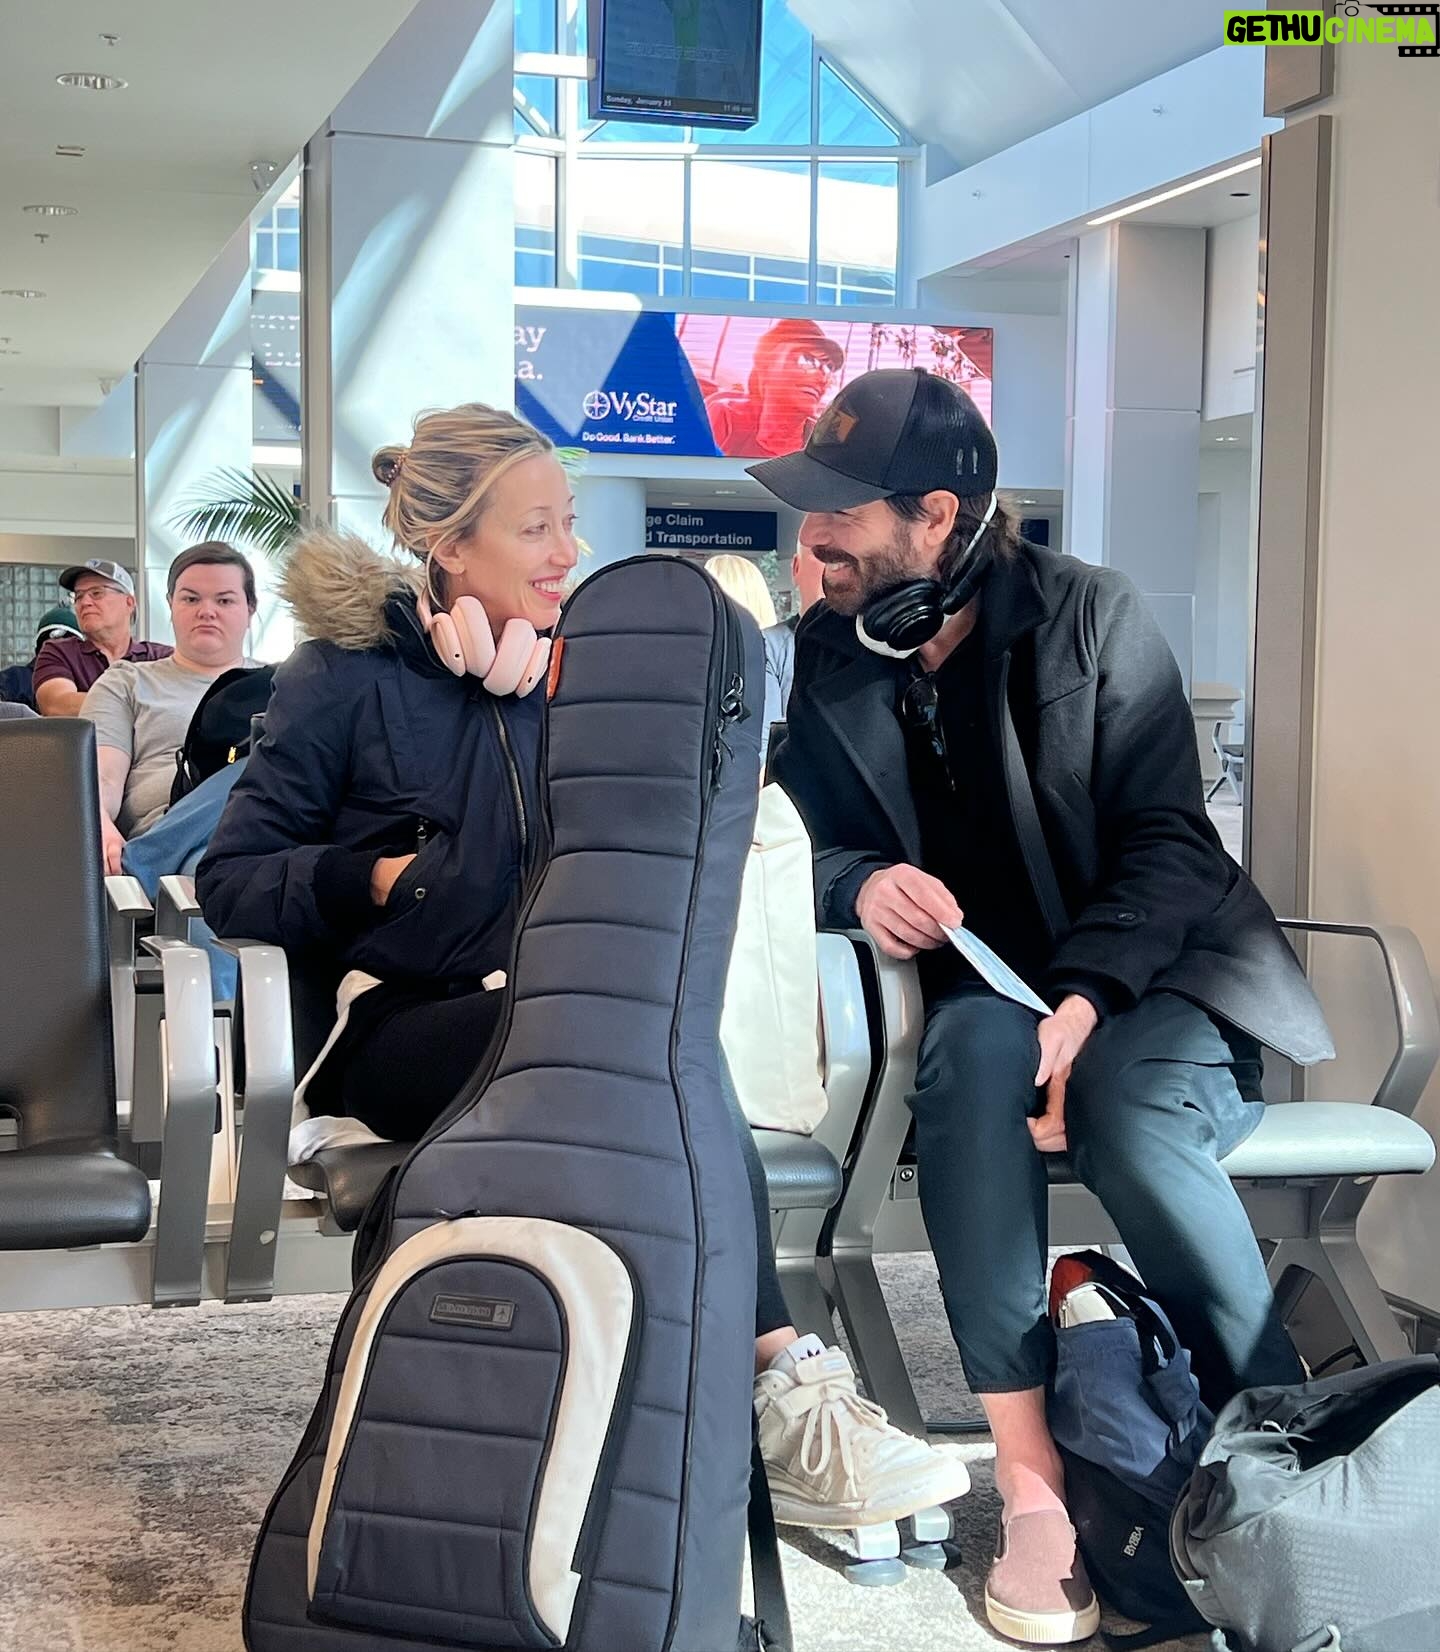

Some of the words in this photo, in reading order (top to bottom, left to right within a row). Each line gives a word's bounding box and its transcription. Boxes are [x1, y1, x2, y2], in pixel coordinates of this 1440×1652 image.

[606, 95, 634, 105] Sunday,
[635, 97, 662, 108] January
[514, 360, 543, 379] a.
[608, 391, 677, 421] VyStar
[582, 431, 596, 442] Do
[596, 432, 622, 442] Good.
[666, 513, 704, 526] Claim
[656, 531, 752, 546] Transportation
